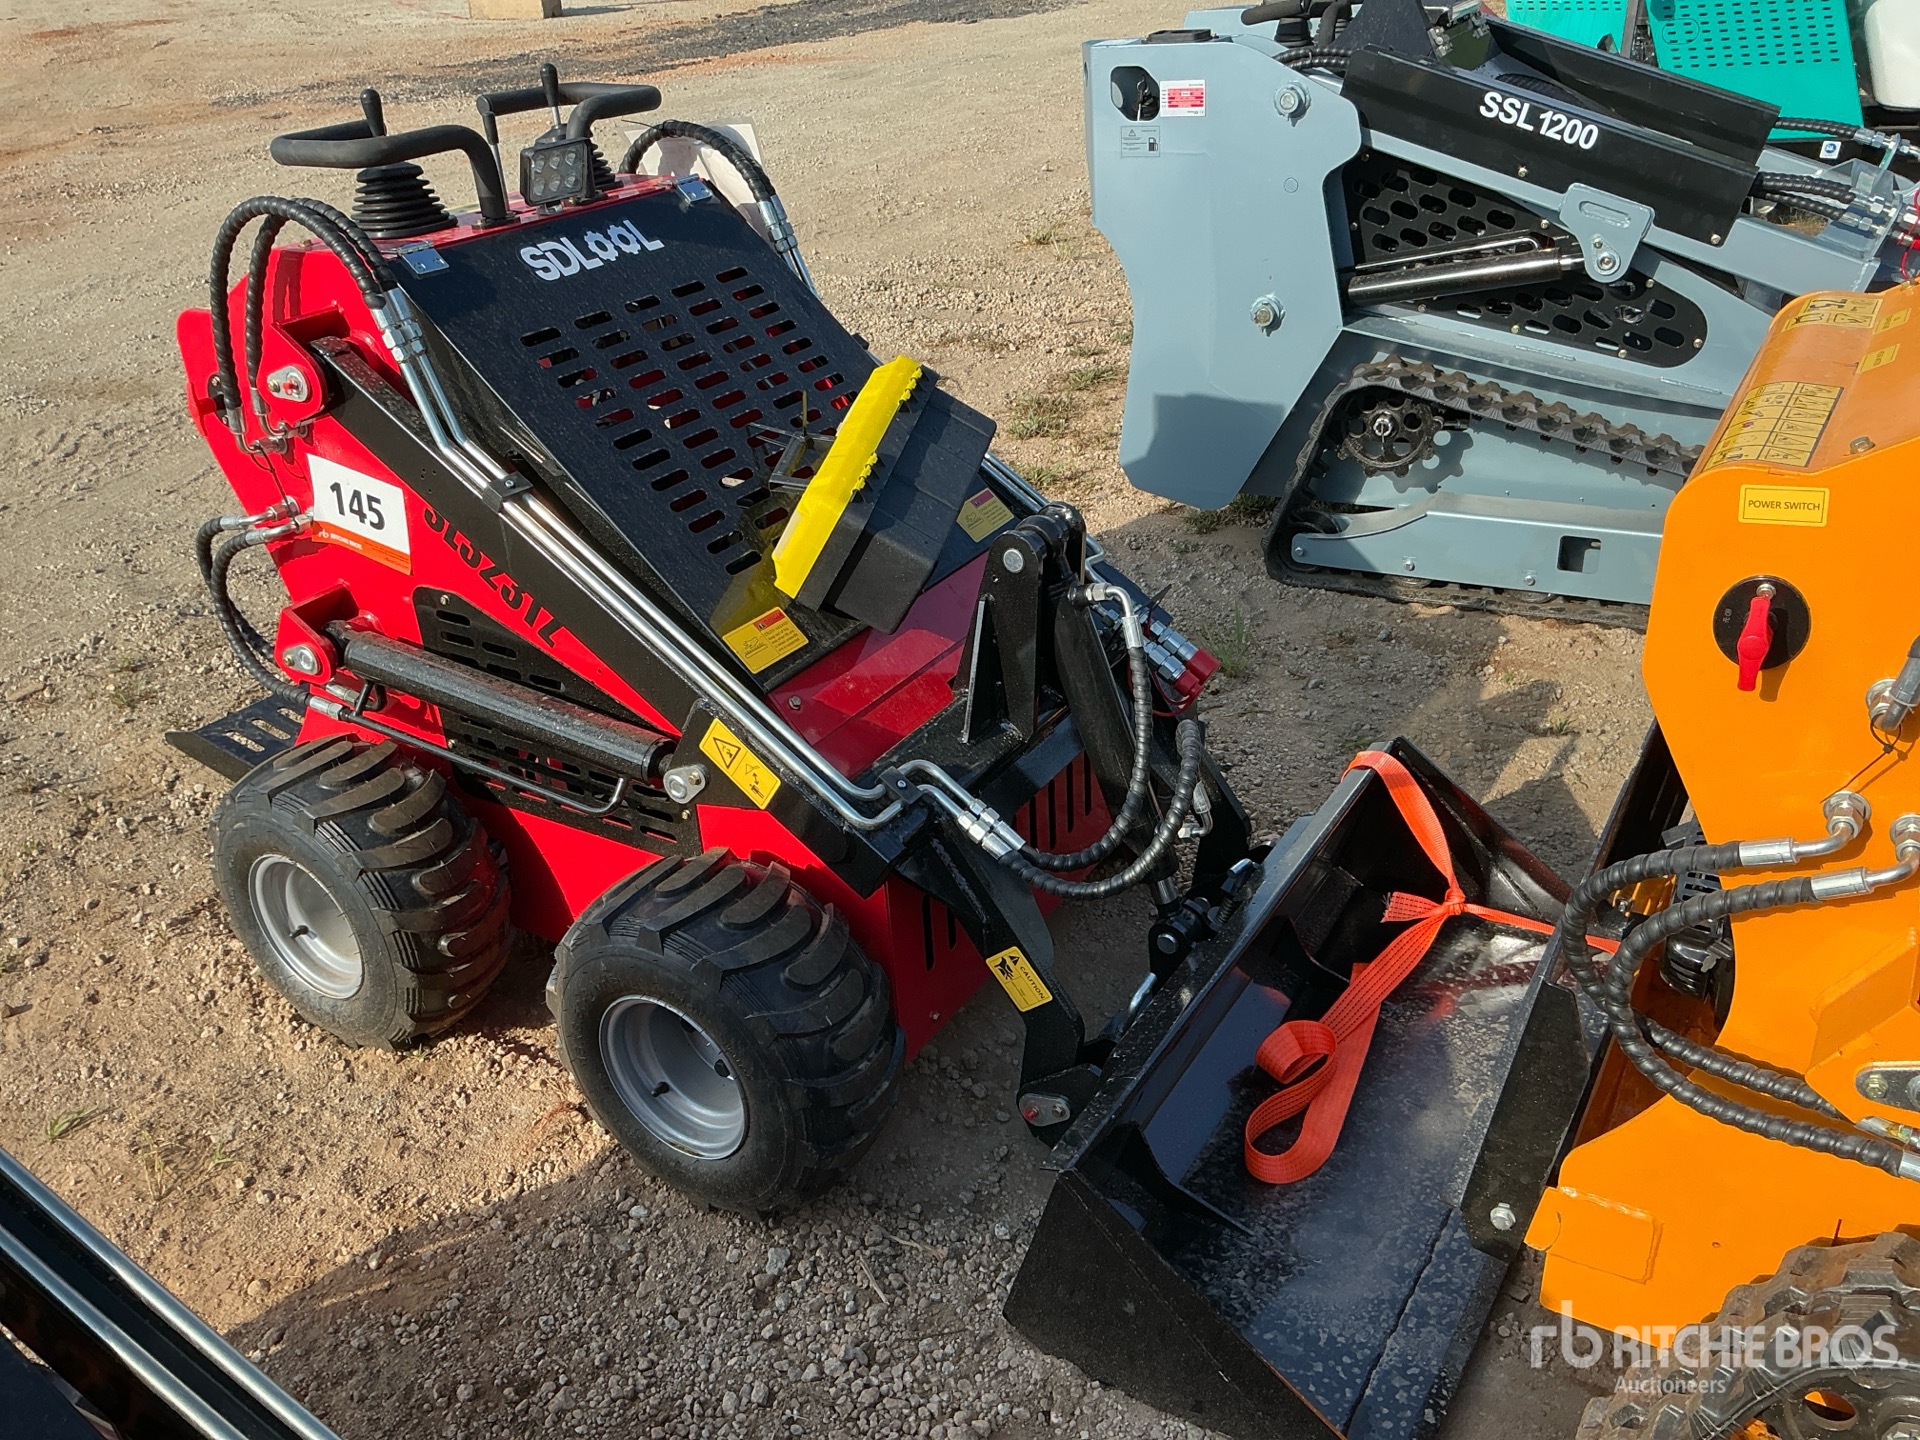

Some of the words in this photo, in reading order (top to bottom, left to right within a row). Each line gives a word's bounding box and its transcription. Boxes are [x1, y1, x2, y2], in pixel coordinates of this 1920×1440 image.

[1480, 91, 1534, 132] SSL
[1539, 110, 1599, 150] 1200
[520, 219, 665, 281] SDLOOL
[329, 481, 385, 531] 145
[1748, 499, 1781, 510] POWER
[1783, 501, 1820, 511] SWITCH
[1020, 966, 1045, 999] CAUTION
